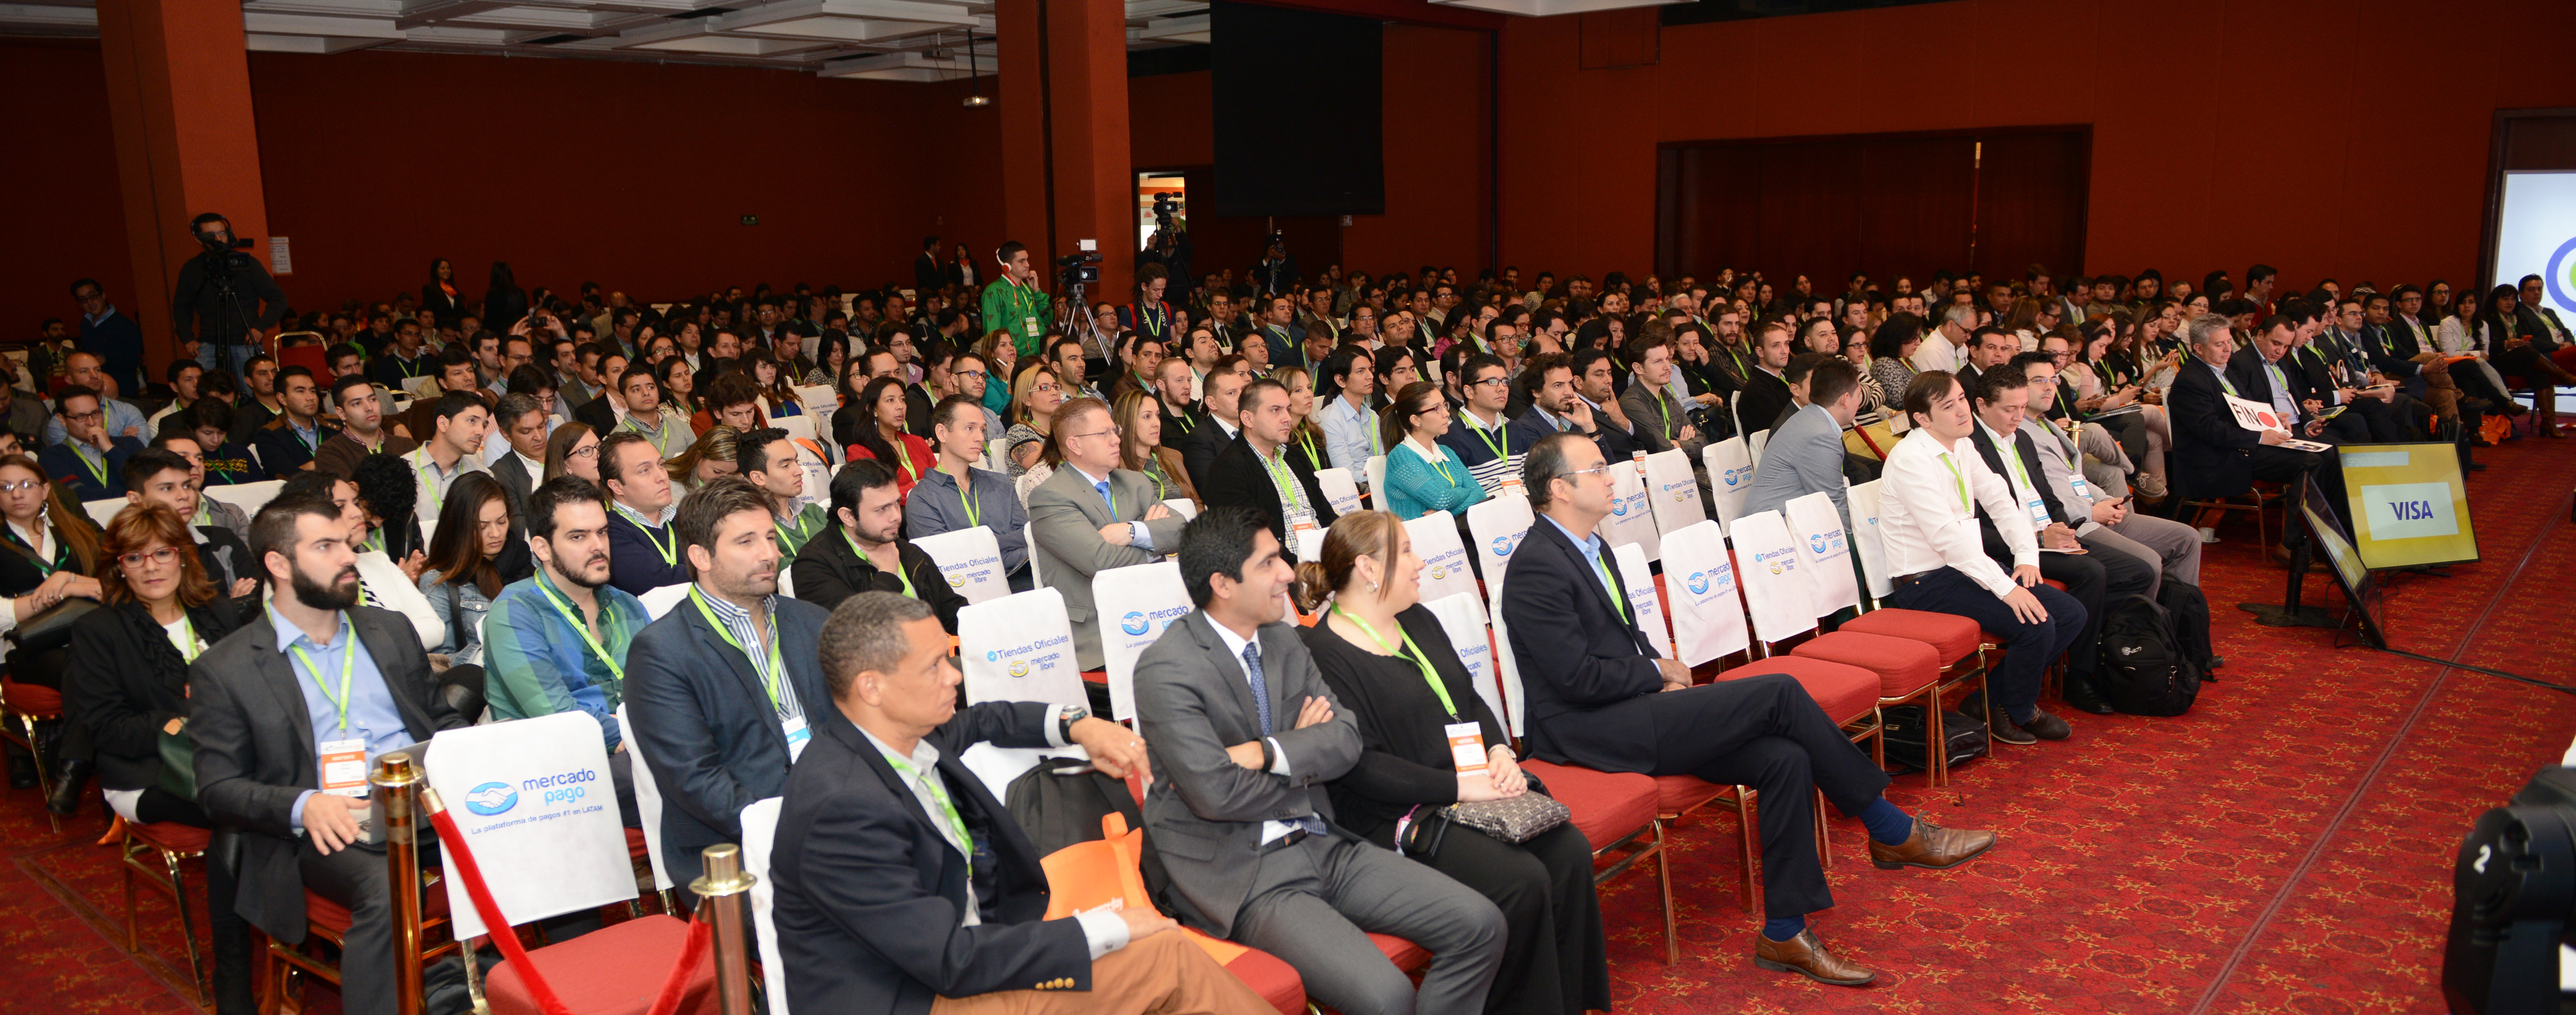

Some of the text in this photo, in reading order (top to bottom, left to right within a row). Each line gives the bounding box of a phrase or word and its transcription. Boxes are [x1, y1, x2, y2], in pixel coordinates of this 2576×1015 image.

[2231, 402, 2262, 426] FIN
[1339, 494, 1358, 502] Oficiales
[1626, 491, 1645, 503] mercado
[1634, 501, 1645, 510] pago
[2387, 501, 2433, 521] VISA
[1824, 528, 1842, 540] mercado
[1832, 538, 1842, 549] pago
[1761, 550, 1780, 560] Tiendas
[938, 556, 999, 572] Tiendas Oficiales
[1446, 559, 1463, 570] mercado
[966, 569, 991, 578] mercado
[1717, 573, 1731, 587] pago
[1636, 586, 1656, 596] Oficiales
[1636, 600, 1653, 610] mercado
[1149, 605, 1189, 620] mercado
[996, 635, 1068, 659] Tiendas Oficiales
[1460, 644, 1488, 657] Oficiales
[1030, 652, 1060, 665] mercado
[1040, 662, 1055, 671] libre
[522, 768, 595, 791] mercado
[544, 786, 585, 806] pago
[484, 818, 526, 833] plataforma
[539, 812, 560, 821] pagos
[581, 805, 602, 813] LATAM
[2473, 844, 2492, 874] 2
